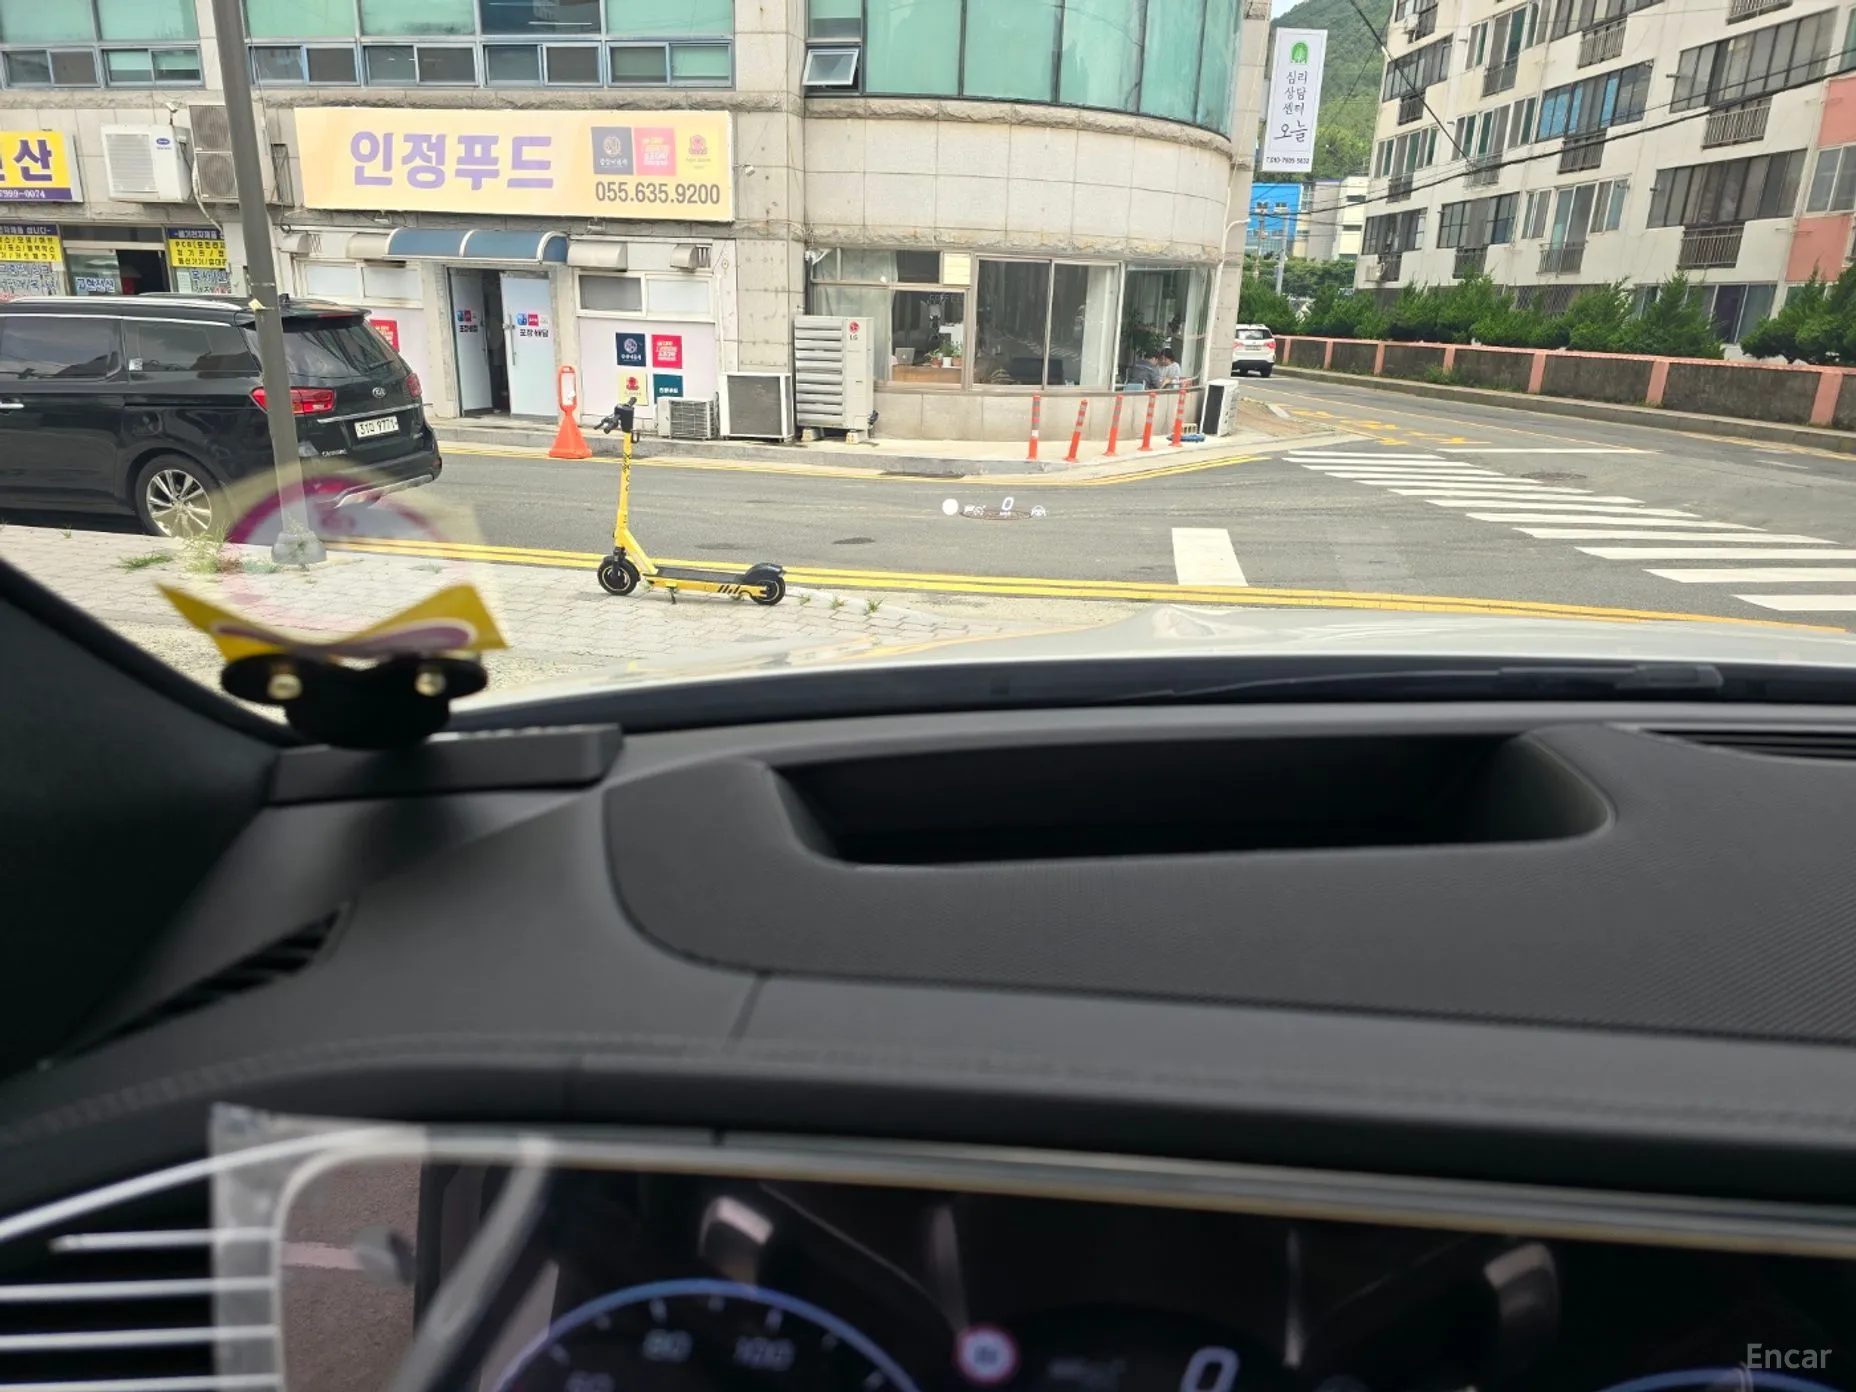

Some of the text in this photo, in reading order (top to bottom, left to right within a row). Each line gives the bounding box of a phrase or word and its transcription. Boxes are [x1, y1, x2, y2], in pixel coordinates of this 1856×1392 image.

[1285, 70, 1309, 86] 심리
[1283, 87, 1307, 102] 상담
[1281, 102, 1305, 117] 센터
[1273, 119, 1308, 144] 오늘
[349, 130, 555, 192] 인정푸드
[594, 181, 721, 205] 055.635.9200
[1001, 496, 1015, 511] 0
[1180, 1345, 1241, 1392] 0
